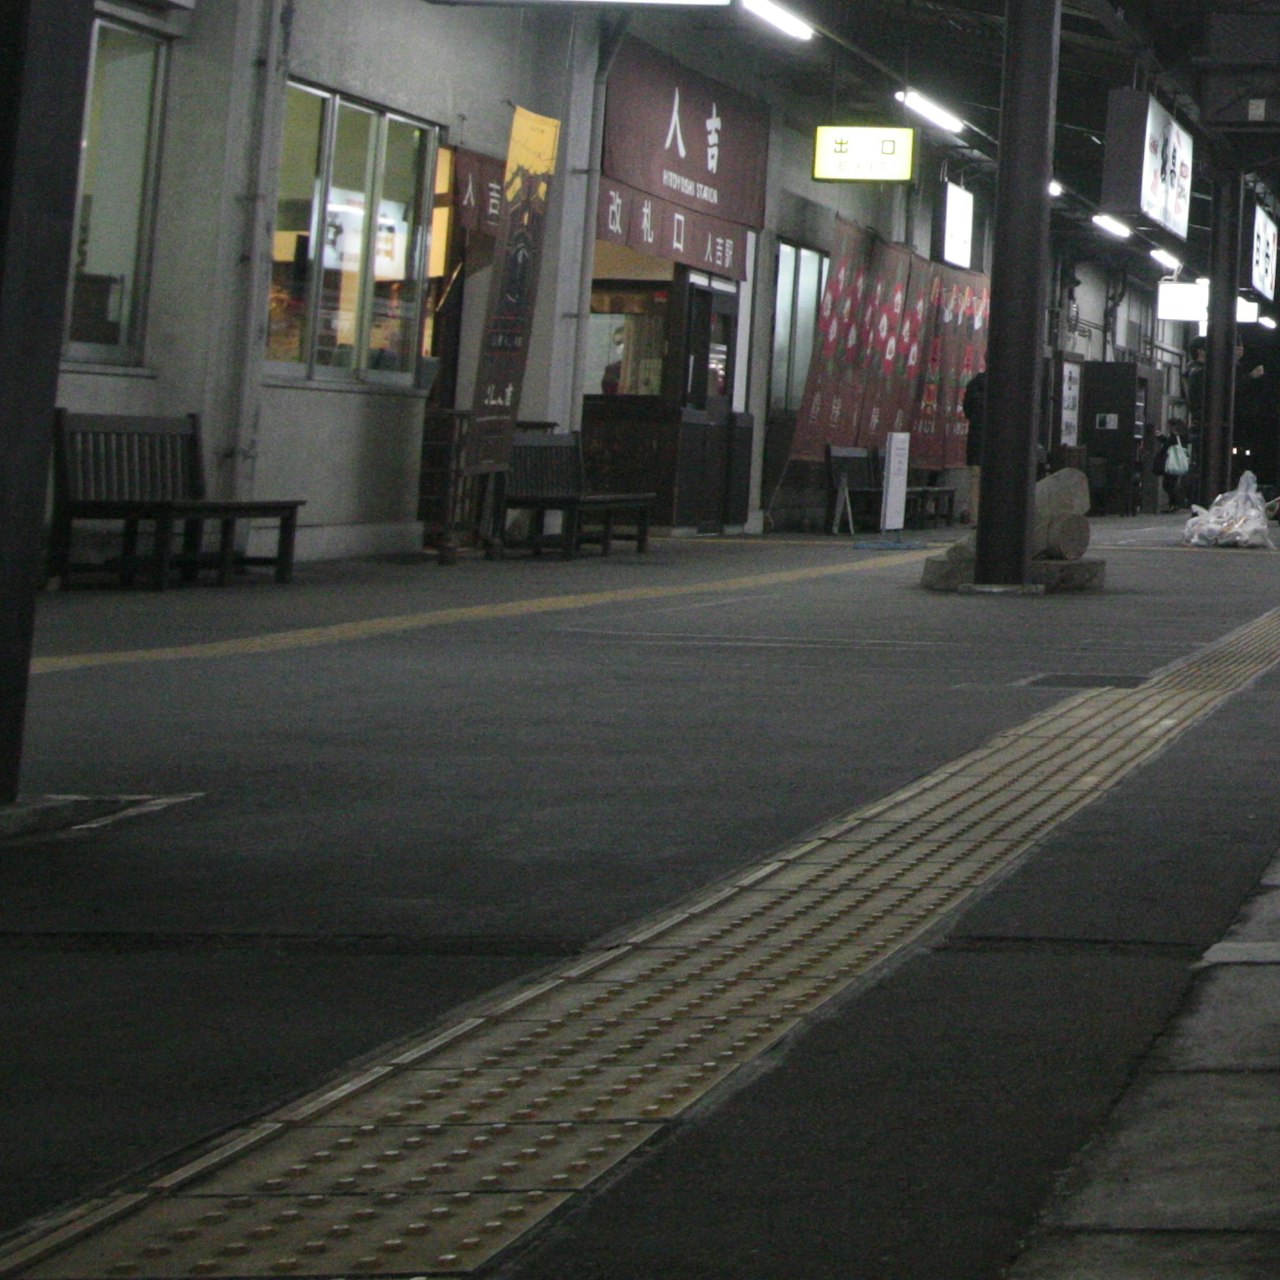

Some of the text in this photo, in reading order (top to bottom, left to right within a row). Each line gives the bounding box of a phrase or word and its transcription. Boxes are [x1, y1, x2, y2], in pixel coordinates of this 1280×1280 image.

[663, 86, 722, 175] 人吉
[833, 137, 896, 155] 出口
[662, 169, 718, 204] HITOYOSHI STATION
[608, 190, 686, 253] 改札口
